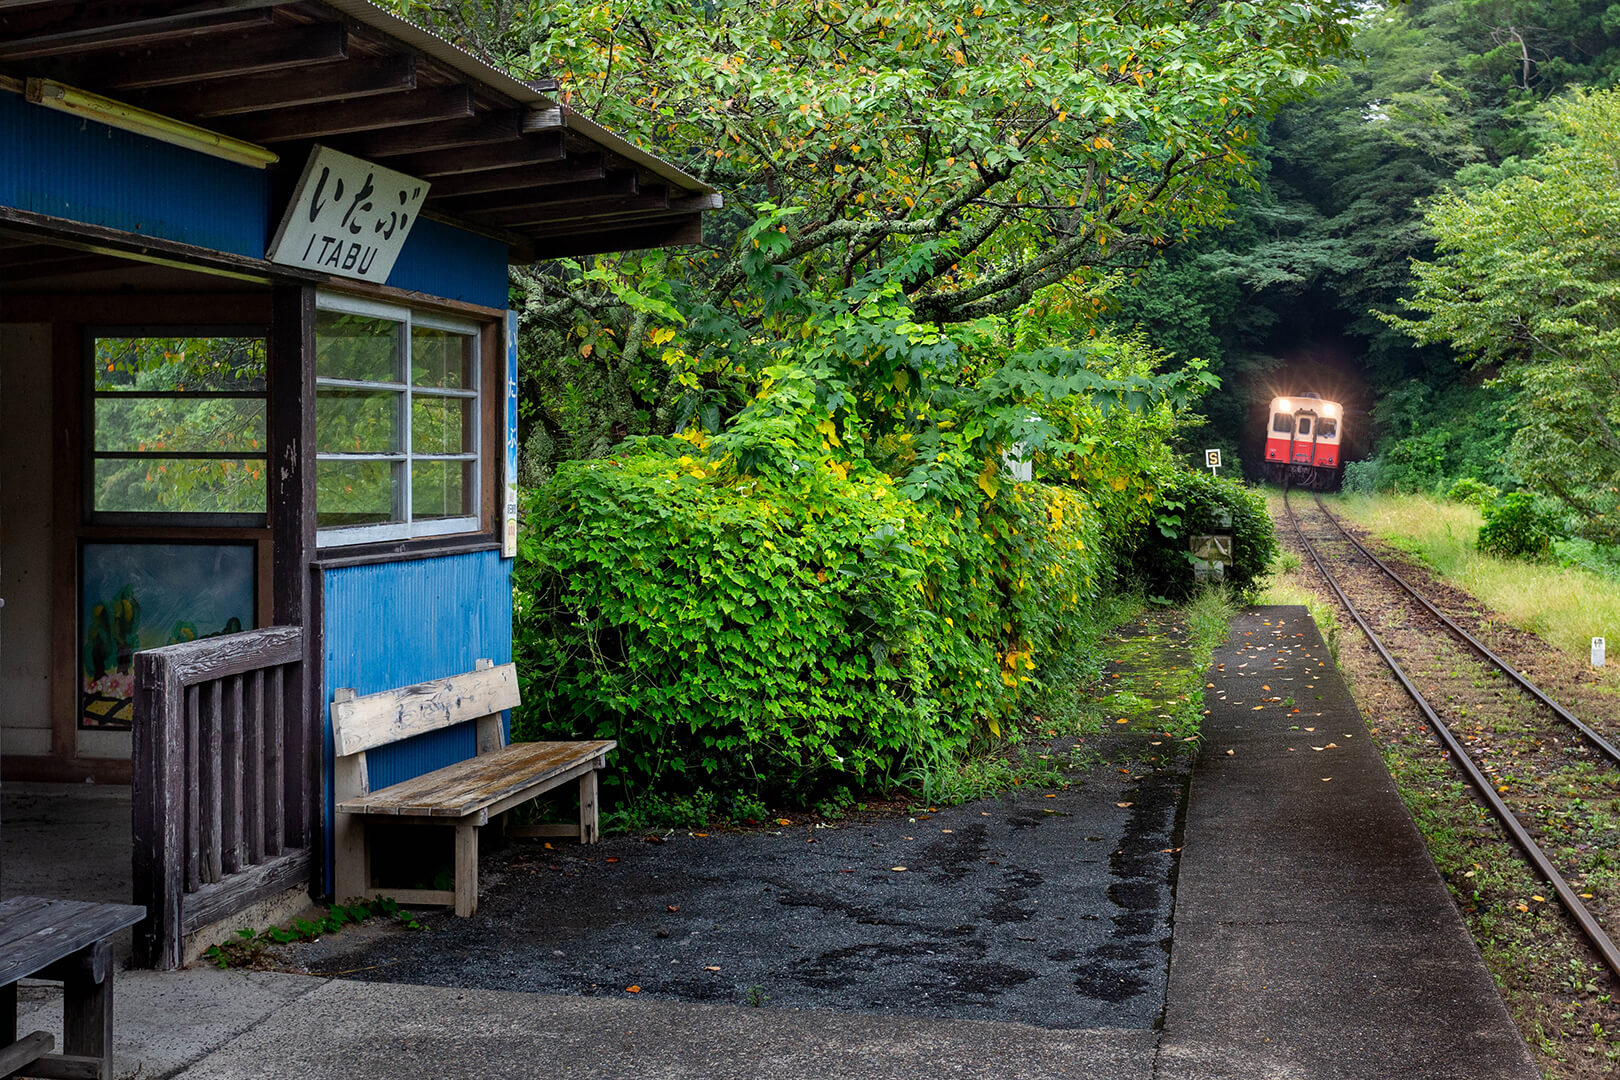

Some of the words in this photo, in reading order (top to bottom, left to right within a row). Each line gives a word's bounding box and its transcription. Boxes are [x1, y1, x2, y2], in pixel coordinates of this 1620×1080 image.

[309, 166, 421, 241] いたぶ
[302, 233, 378, 275] ITABU
[507, 329, 517, 449] いたぶ
[1209, 452, 1218, 465] S
